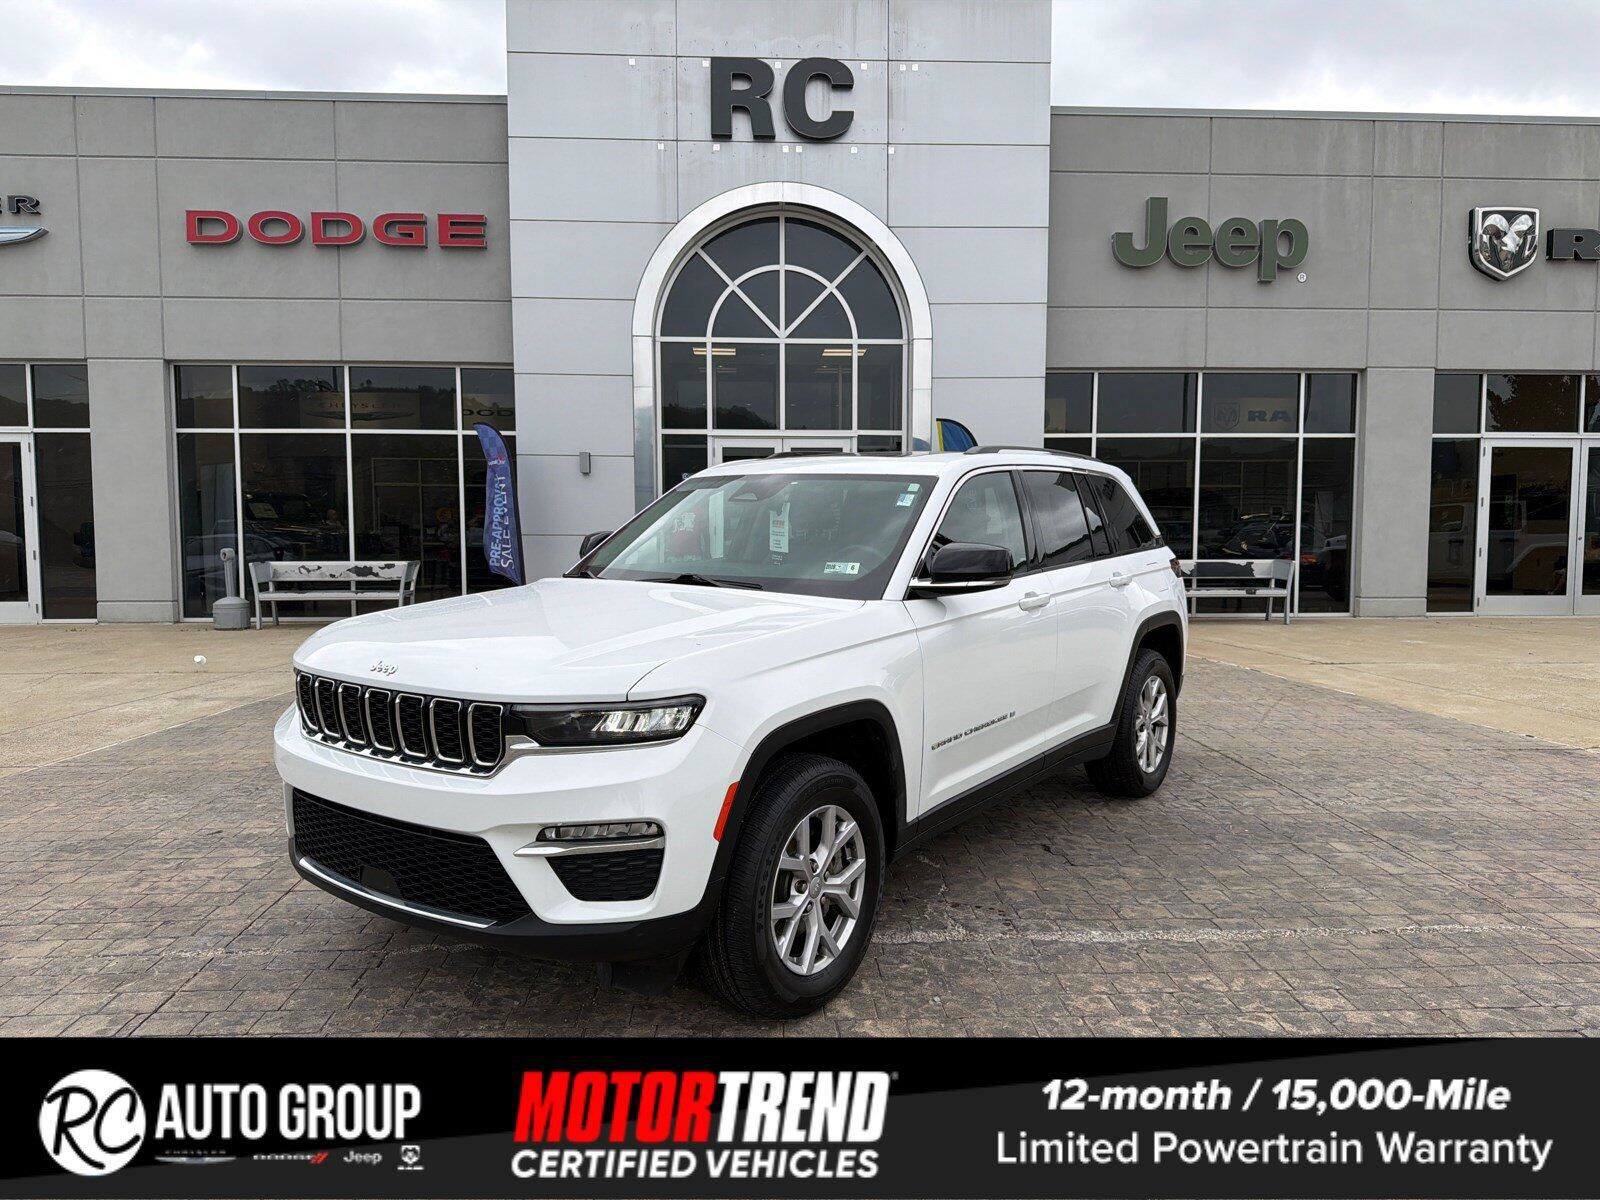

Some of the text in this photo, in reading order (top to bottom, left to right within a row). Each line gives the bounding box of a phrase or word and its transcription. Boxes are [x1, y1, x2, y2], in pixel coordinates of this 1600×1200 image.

[709, 57, 855, 141] RC
[0, 194, 41, 215] R
[185, 209, 488, 250] DODGE
[1111, 196, 1309, 284] Jeep
[1546, 227, 1600, 261] R
[489, 476, 504, 568] PRE-APPROV
[501, 529, 515, 570] SALE
[370, 660, 398, 677] Jeep
